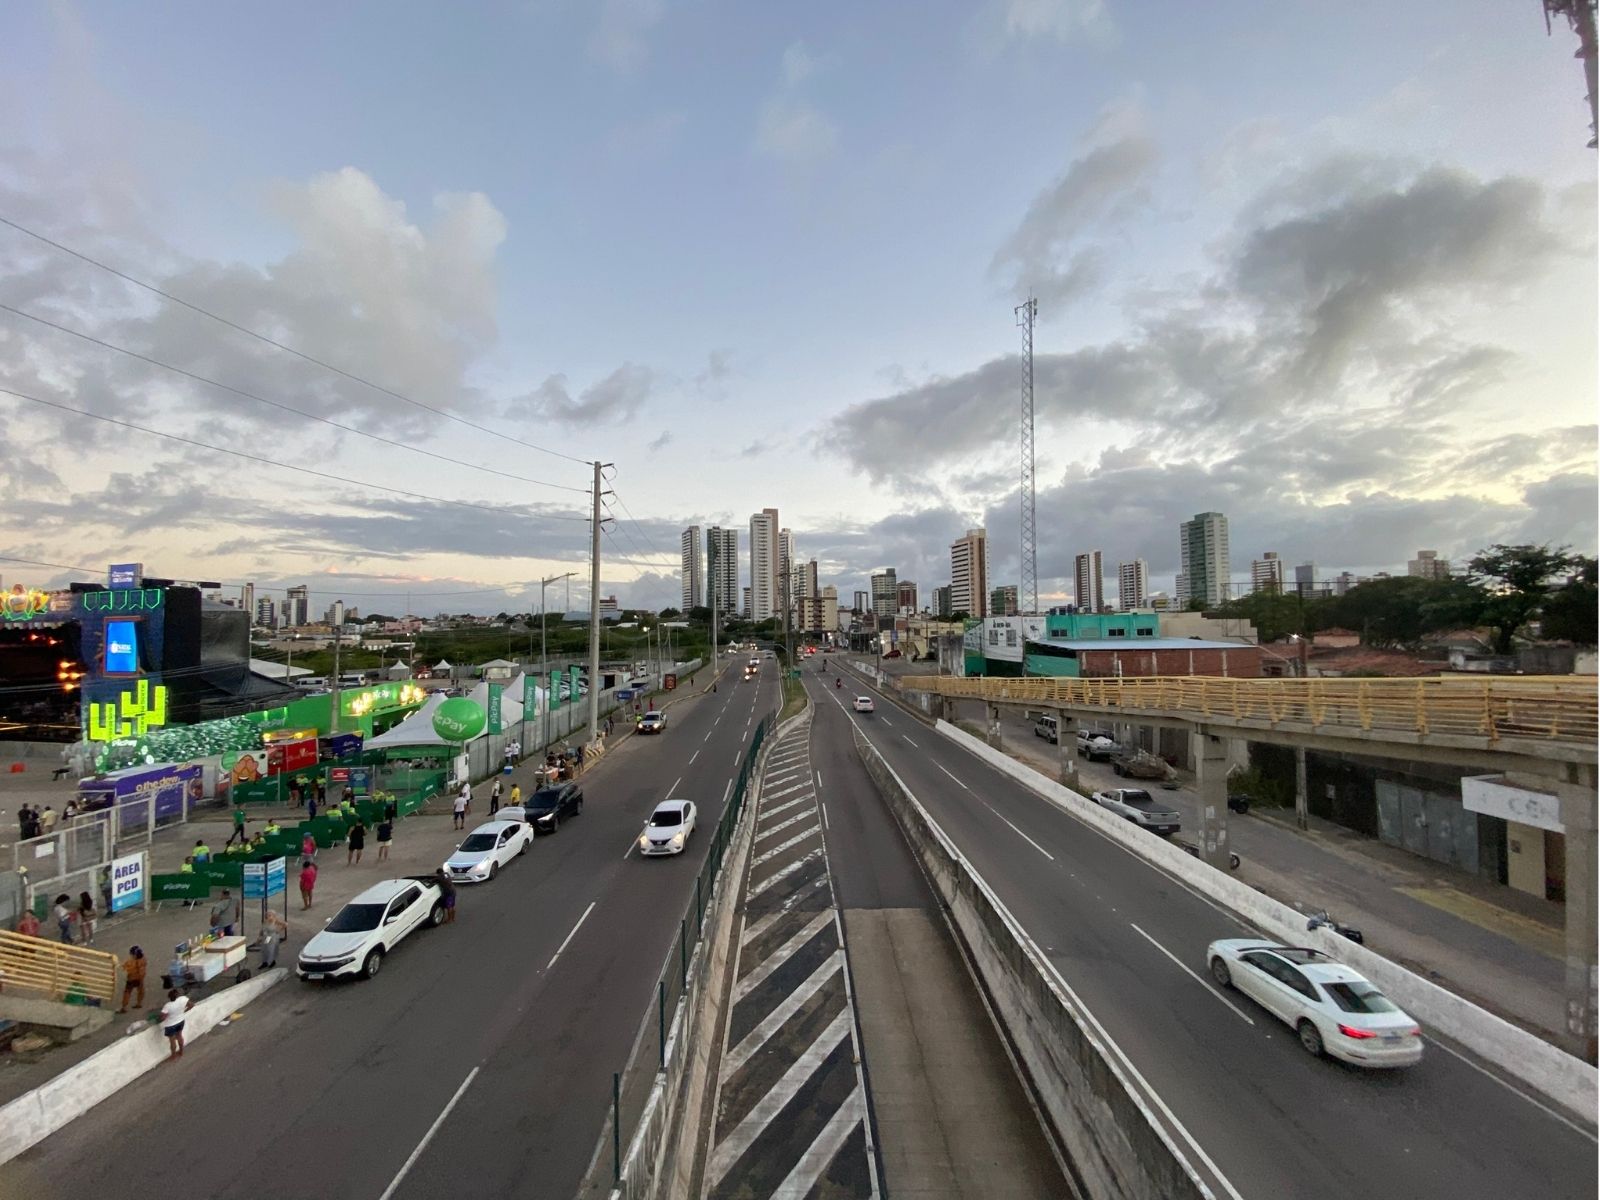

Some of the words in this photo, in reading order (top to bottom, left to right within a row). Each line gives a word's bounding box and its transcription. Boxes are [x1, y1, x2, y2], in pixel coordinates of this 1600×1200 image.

[432, 709, 467, 733] icPay
[490, 696, 499, 724] PicPay
[117, 878, 138, 894] PCD
